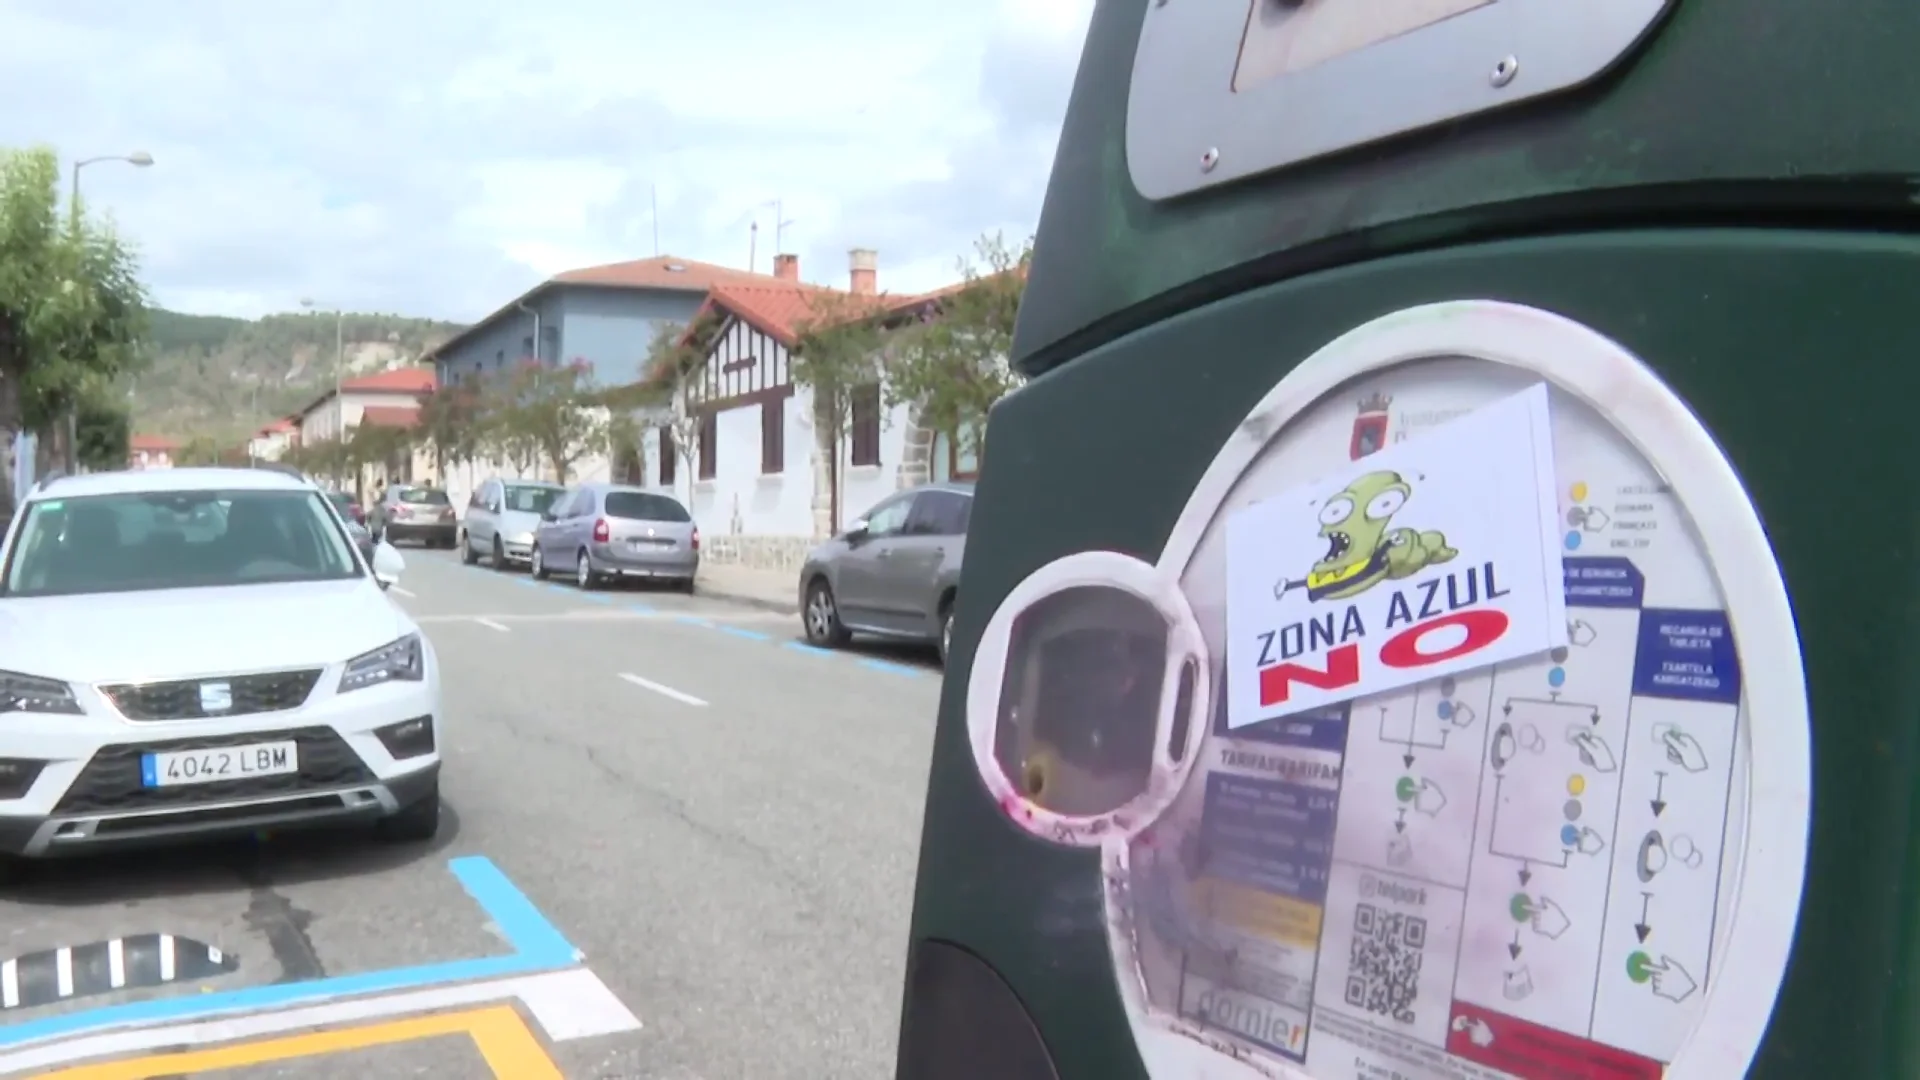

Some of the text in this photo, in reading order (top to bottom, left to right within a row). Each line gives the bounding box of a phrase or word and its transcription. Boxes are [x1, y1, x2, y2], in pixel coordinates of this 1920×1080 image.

[1257, 561, 1511, 667] ZONA AZUL
[1259, 609, 1509, 708] NO
[167, 747, 286, 778] 4042 LBM
[1199, 990, 1306, 1048] dornier
